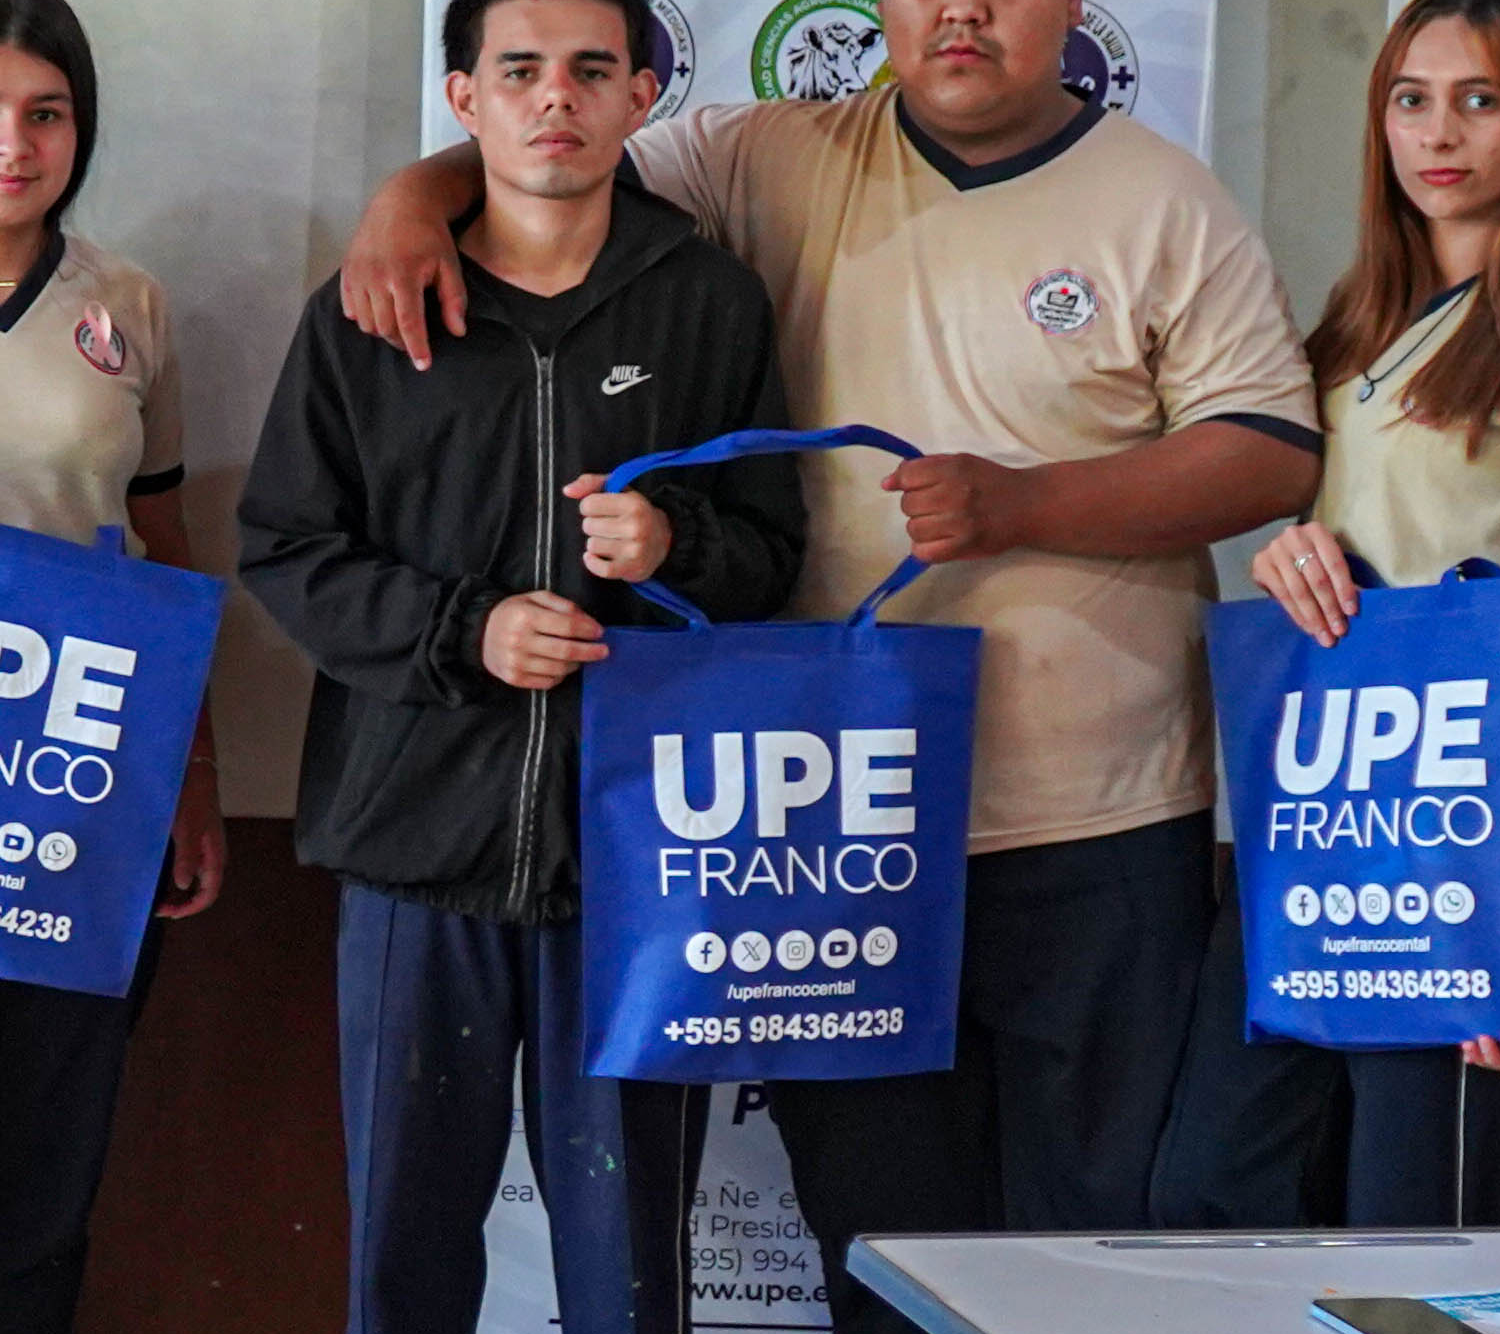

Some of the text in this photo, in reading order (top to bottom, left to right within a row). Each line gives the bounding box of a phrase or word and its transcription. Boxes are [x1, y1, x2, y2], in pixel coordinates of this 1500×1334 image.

[610, 364, 642, 382] NIKE
[1274, 678, 1489, 796] UPE
[653, 728, 918, 841] UPE
[1268, 794, 1495, 852] FRANCO
[658, 841, 919, 898] FRANCO
[1271, 968, 1492, 1001] +595 984364238
[663, 1006, 905, 1046] +595 984364238
[753, 1248, 809, 1275] 994
